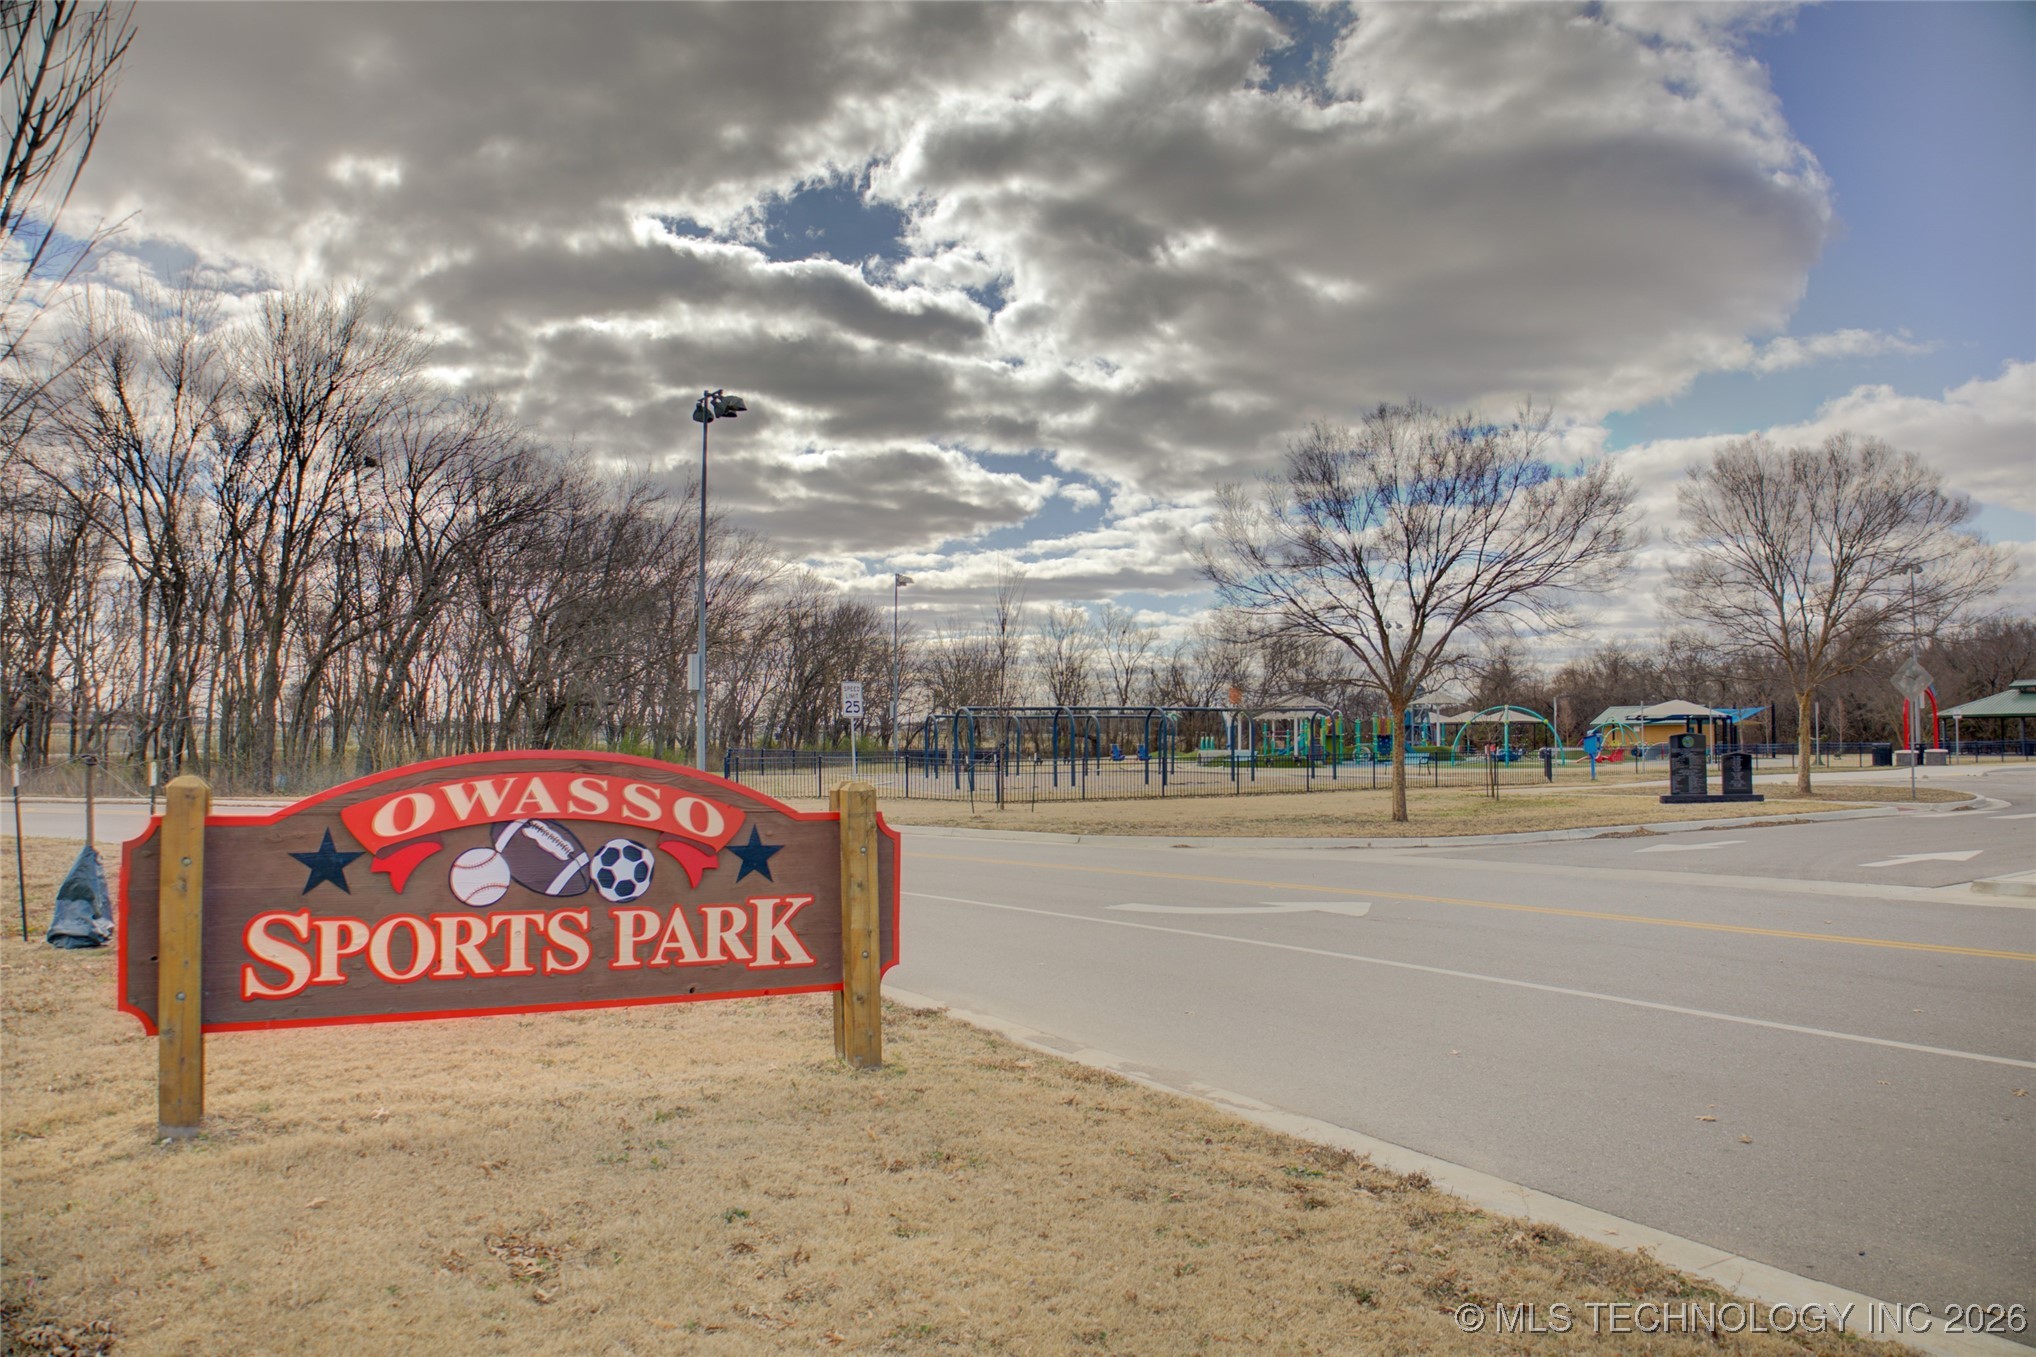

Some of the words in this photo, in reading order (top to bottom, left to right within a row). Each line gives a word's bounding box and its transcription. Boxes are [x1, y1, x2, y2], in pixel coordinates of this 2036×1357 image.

[845, 700, 861, 713] 25
[371, 776, 726, 839] OWASSO
[243, 909, 591, 999] SPORTS
[611, 896, 816, 968] PARK
